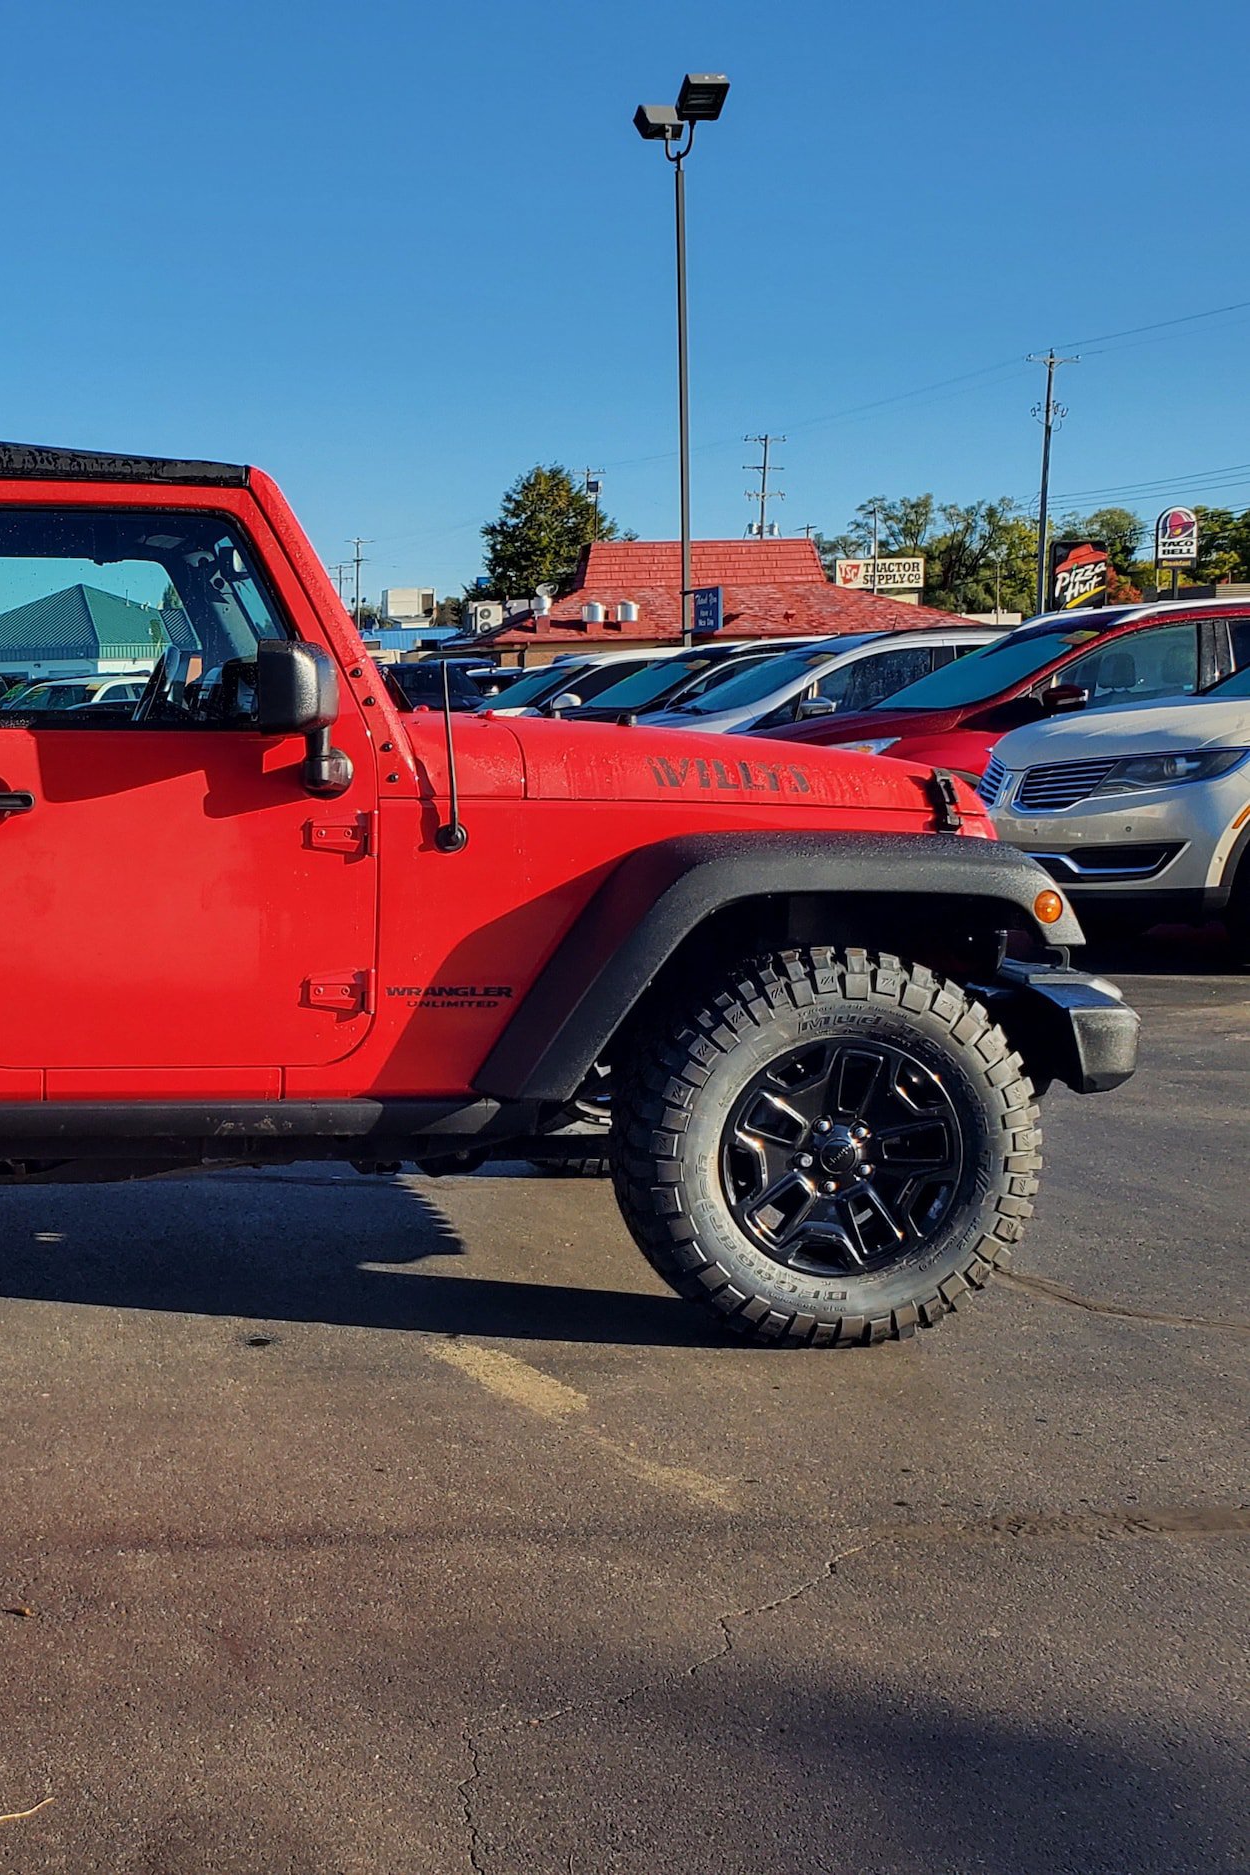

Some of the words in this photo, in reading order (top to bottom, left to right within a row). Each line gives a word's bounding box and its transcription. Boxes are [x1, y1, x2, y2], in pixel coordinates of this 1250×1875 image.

[840, 564, 858, 581] TSC
[863, 562, 920, 573] TRACTOR
[863, 574, 906, 585] SUPPLY
[1055, 562, 1107, 598] Pizza
[1064, 576, 1103, 602] Hut
[647, 756, 810, 793] WILLYS
[385, 986, 514, 998] WRANGLER
[406, 1000, 499, 1008] UNLIMITED
